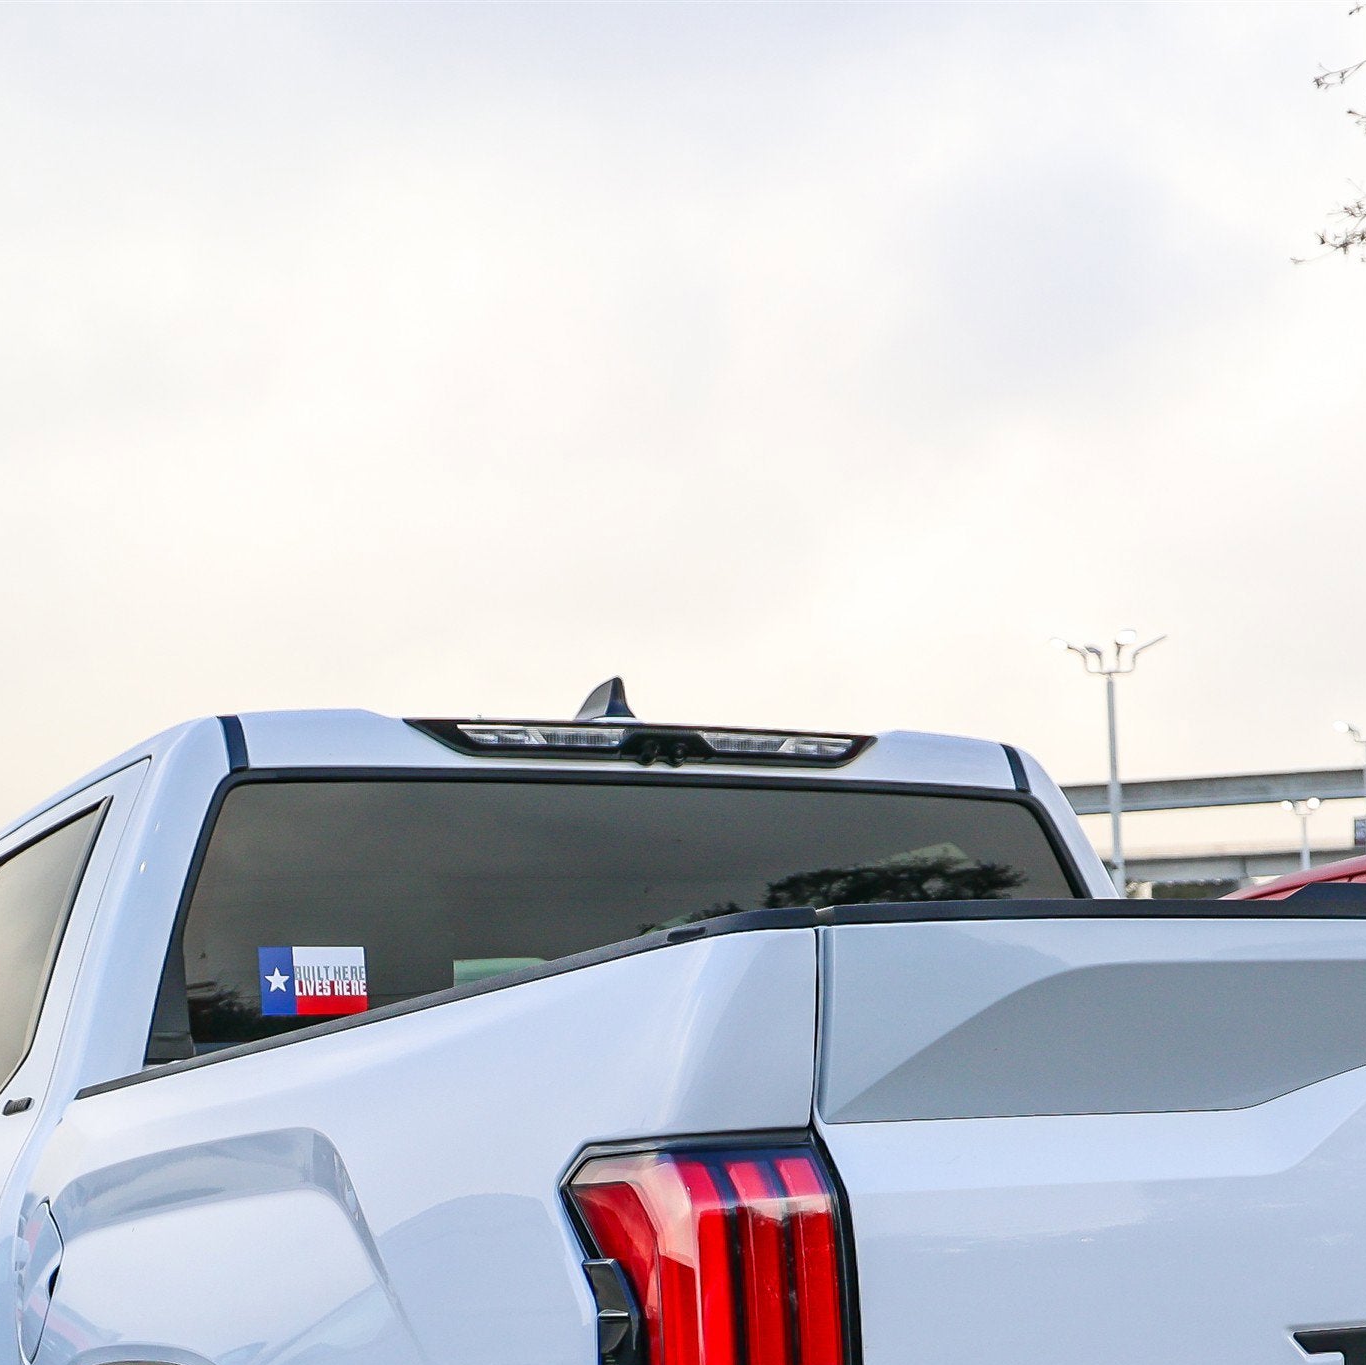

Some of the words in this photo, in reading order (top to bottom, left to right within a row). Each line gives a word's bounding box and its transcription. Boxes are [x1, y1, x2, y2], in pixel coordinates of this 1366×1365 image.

[294, 965, 330, 981] BUILT
[333, 965, 366, 981] HERE
[295, 980, 331, 996] LIVES
[334, 980, 367, 996] HERE
